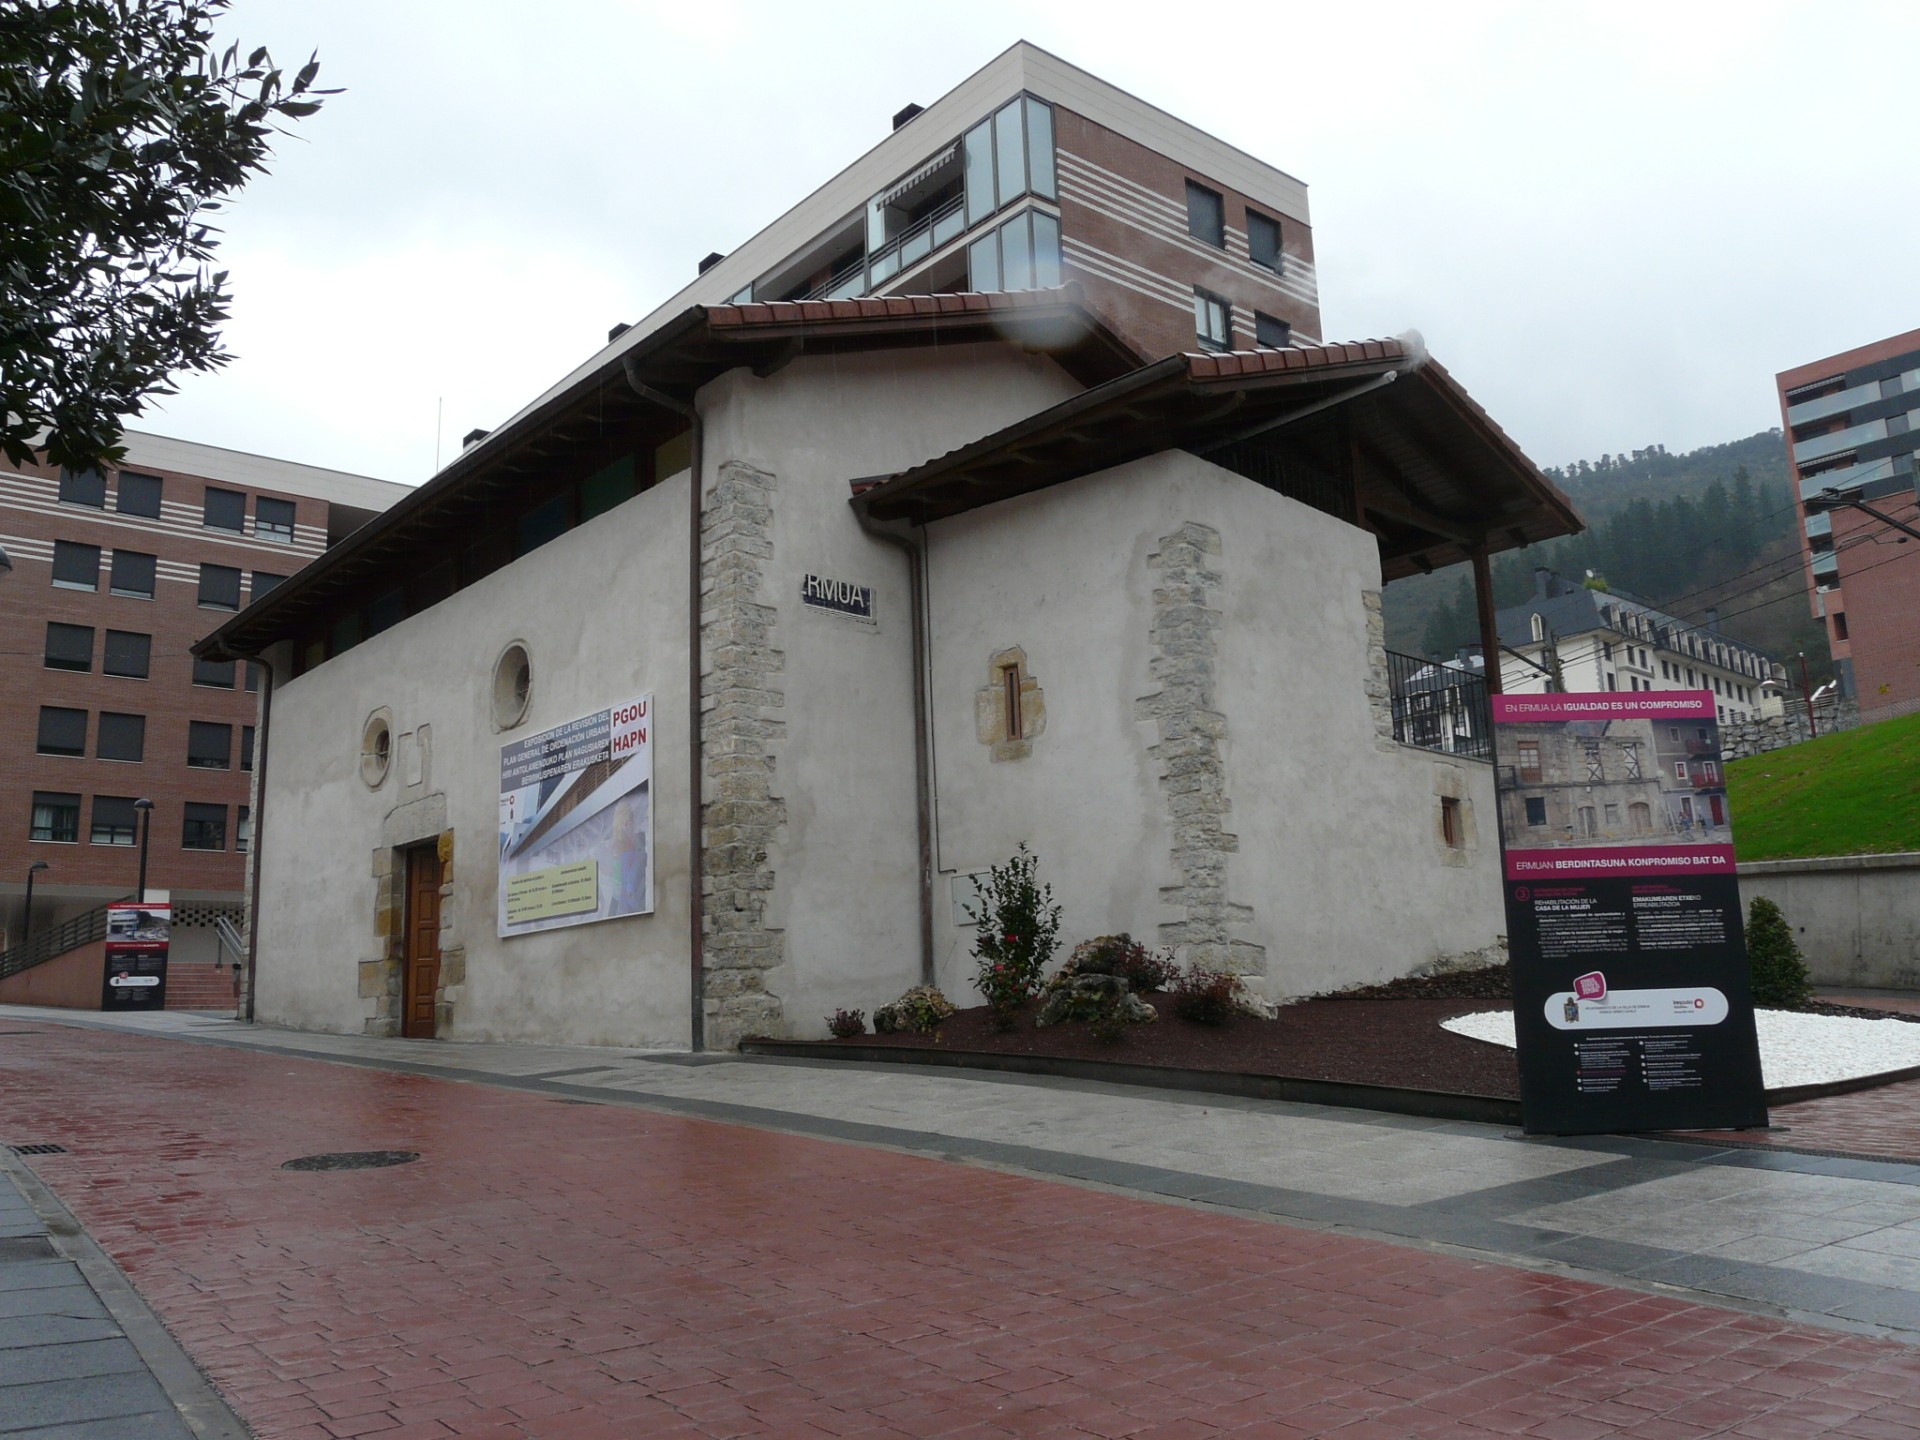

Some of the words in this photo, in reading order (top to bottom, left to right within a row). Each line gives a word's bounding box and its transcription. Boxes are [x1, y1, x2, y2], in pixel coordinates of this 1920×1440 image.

[801, 574, 864, 608] RMUA
[613, 700, 646, 728] PGOU
[1505, 704, 1518, 712] EN
[1519, 703, 1550, 712] ERMUA
[1550, 703, 1562, 712] LA
[1564, 702, 1609, 711] IGUALDAD
[1611, 702, 1623, 710] ES
[1624, 701, 1638, 710] UN
[1640, 700, 1702, 709] COMPROMISO
[556, 728, 562, 737] DE
[564, 725, 572, 734] LA
[598, 712, 610, 723] DEL
[503, 755, 516, 766] PLAN
[518, 748, 540, 762] GENERAL
[542, 744, 549, 753] DE
[586, 724, 610, 740] URBANA
[558, 750, 572, 763] PLAN
[574, 738, 610, 758] NAGUSIAREN
[613, 728, 646, 753] HAPN
[521, 763, 572, 786] BERRIKUSPENAREN
[572, 750, 609, 770] ERAKUSKETA
[1516, 862, 1554, 870] ERMUAN
[1556, 859, 1626, 869] BERDINTASUNA
[1628, 857, 1691, 866] KONPROMISO
[1693, 856, 1710, 864] BAT
[1712, 856, 1726, 864] DA
